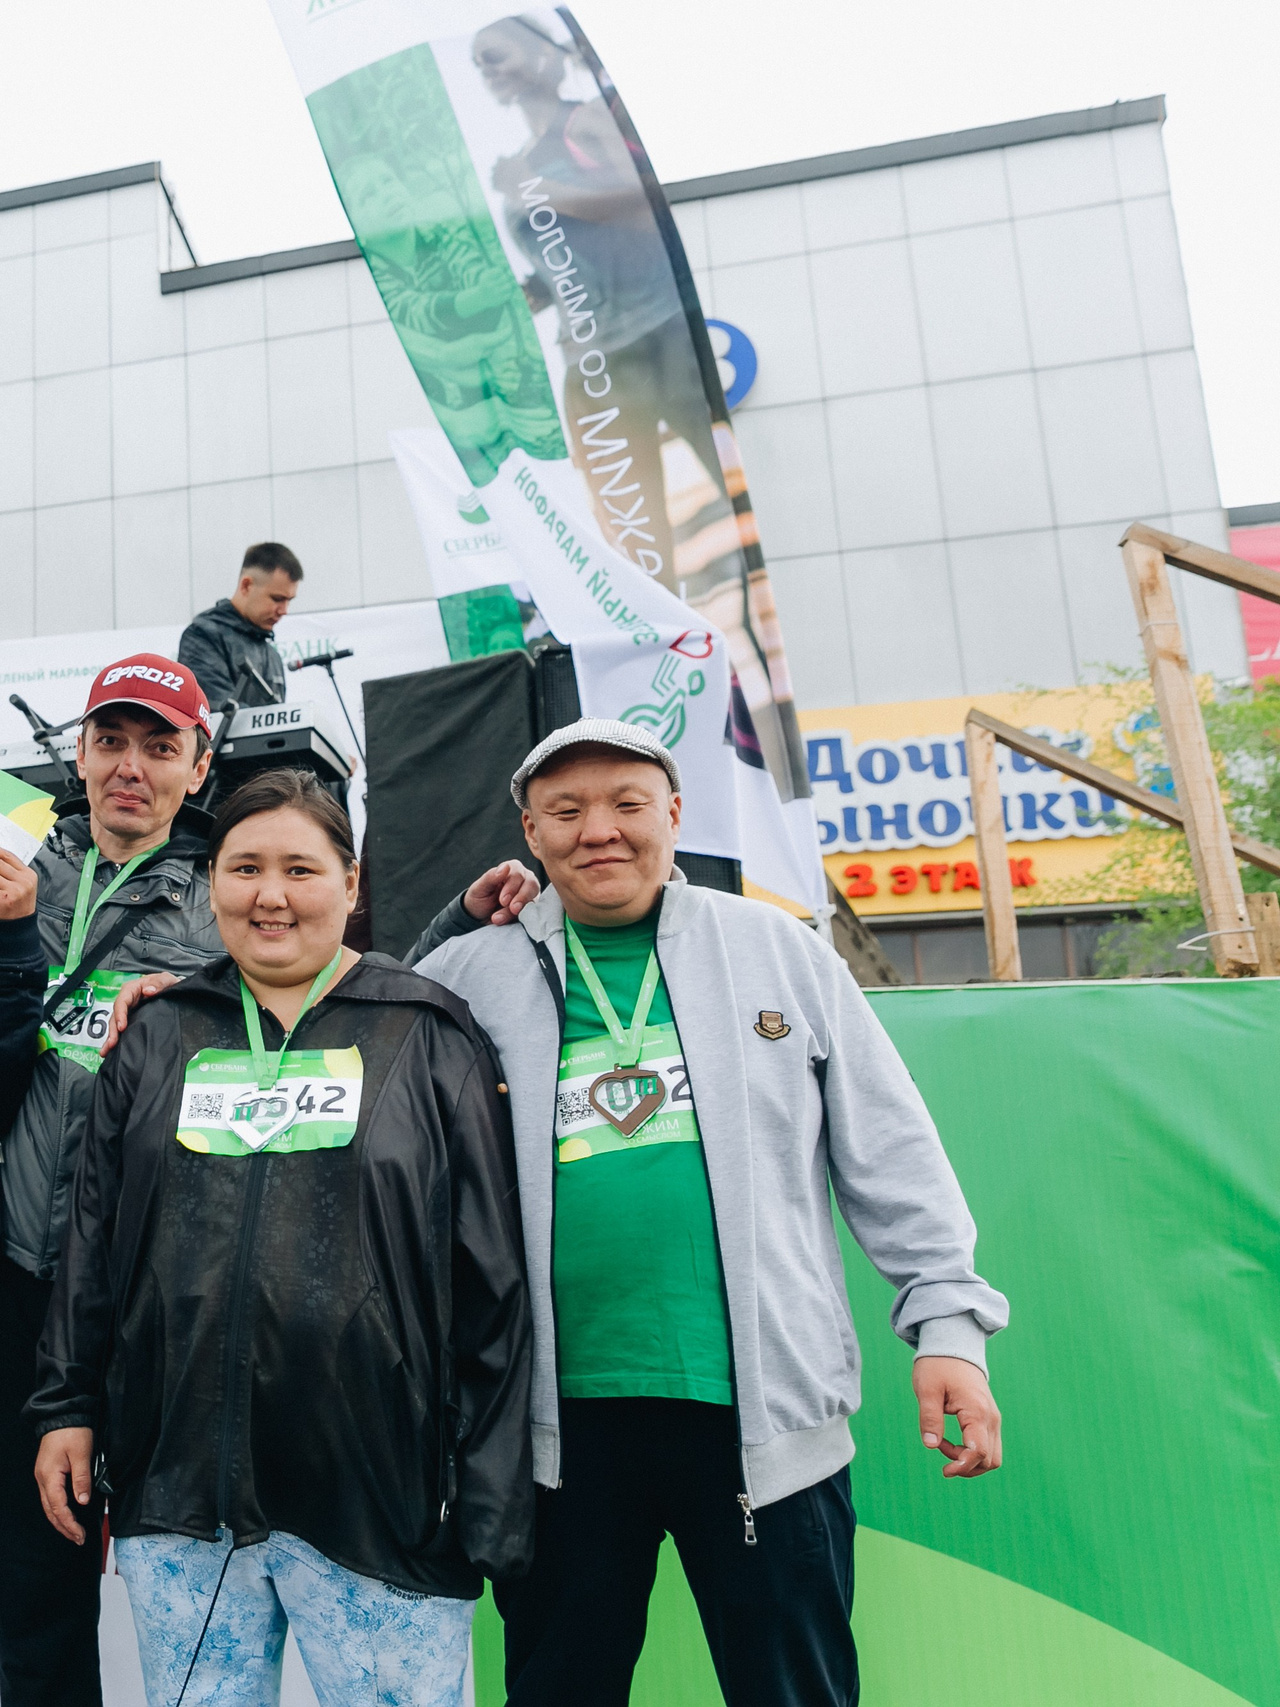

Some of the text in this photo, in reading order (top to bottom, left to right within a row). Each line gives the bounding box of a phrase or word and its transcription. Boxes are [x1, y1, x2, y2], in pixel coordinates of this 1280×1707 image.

[251, 708, 301, 729] KORG
[844, 864, 877, 898] 2
[568, 1050, 606, 1065] СБЕРБАНК
[210, 1064, 248, 1072] СБЕРБАНК
[635, 1118, 680, 1136] жим
